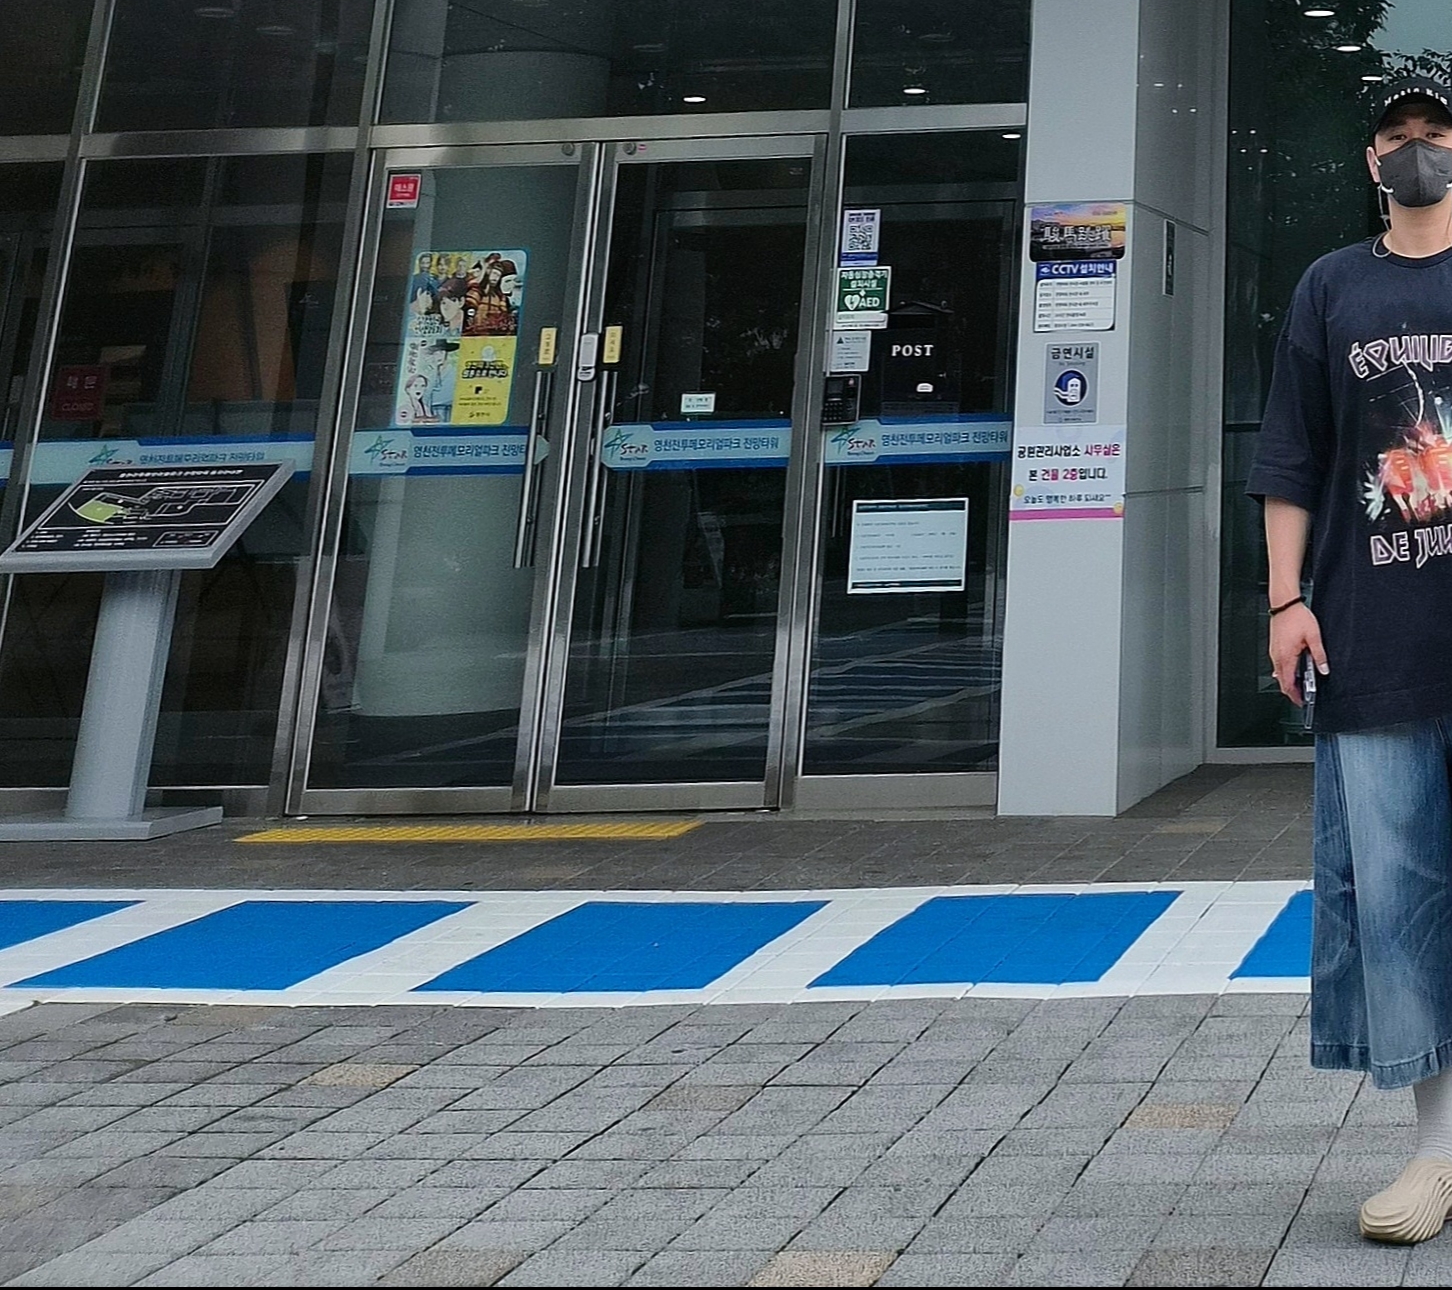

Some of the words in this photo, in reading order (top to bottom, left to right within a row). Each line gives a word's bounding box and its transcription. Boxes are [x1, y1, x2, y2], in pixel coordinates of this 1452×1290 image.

[1052, 264, 1079, 274] CCTV
[859, 297, 880, 307] AED
[891, 345, 934, 357] POST
[1051, 347, 1095, 359] 금연시설
[1017, 445, 1081, 459] 공원관리사업소
[1084, 444, 1121, 456] 사무실은
[1370, 531, 1410, 565] DE
